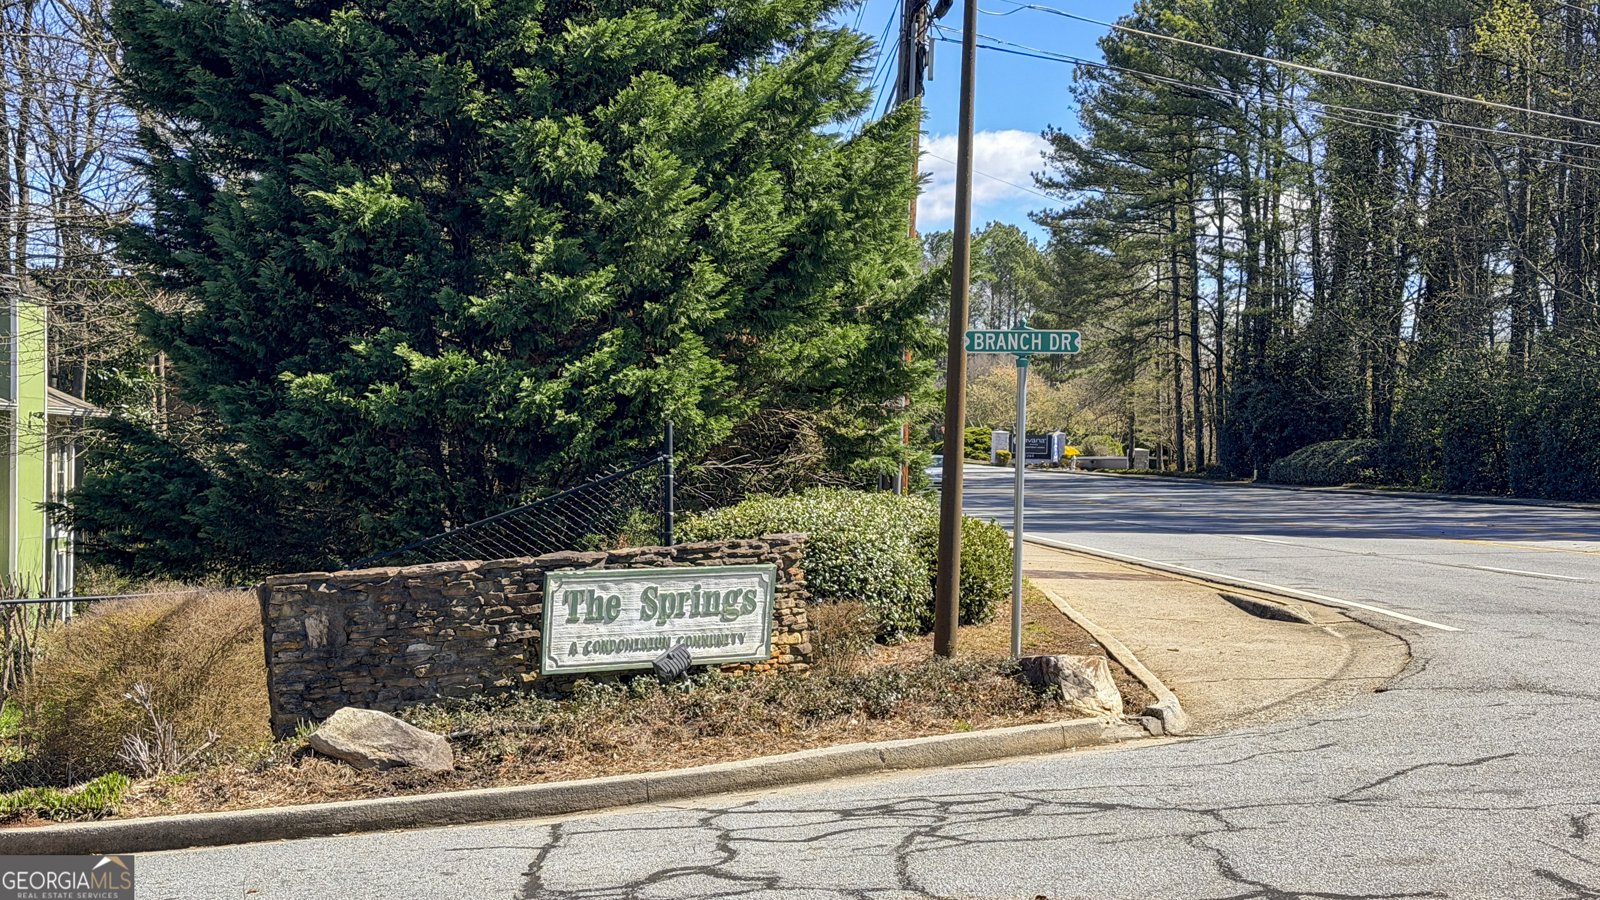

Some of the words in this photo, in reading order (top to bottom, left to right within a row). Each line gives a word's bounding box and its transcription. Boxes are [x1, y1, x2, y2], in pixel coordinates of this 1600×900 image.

[974, 333, 1041, 350] BRANCH
[1049, 333, 1071, 350] DR
[562, 588, 621, 624] The
[639, 584, 758, 626] Springs
[568, 641, 578, 657] A
[583, 636, 671, 656] CONDOMINIUM
